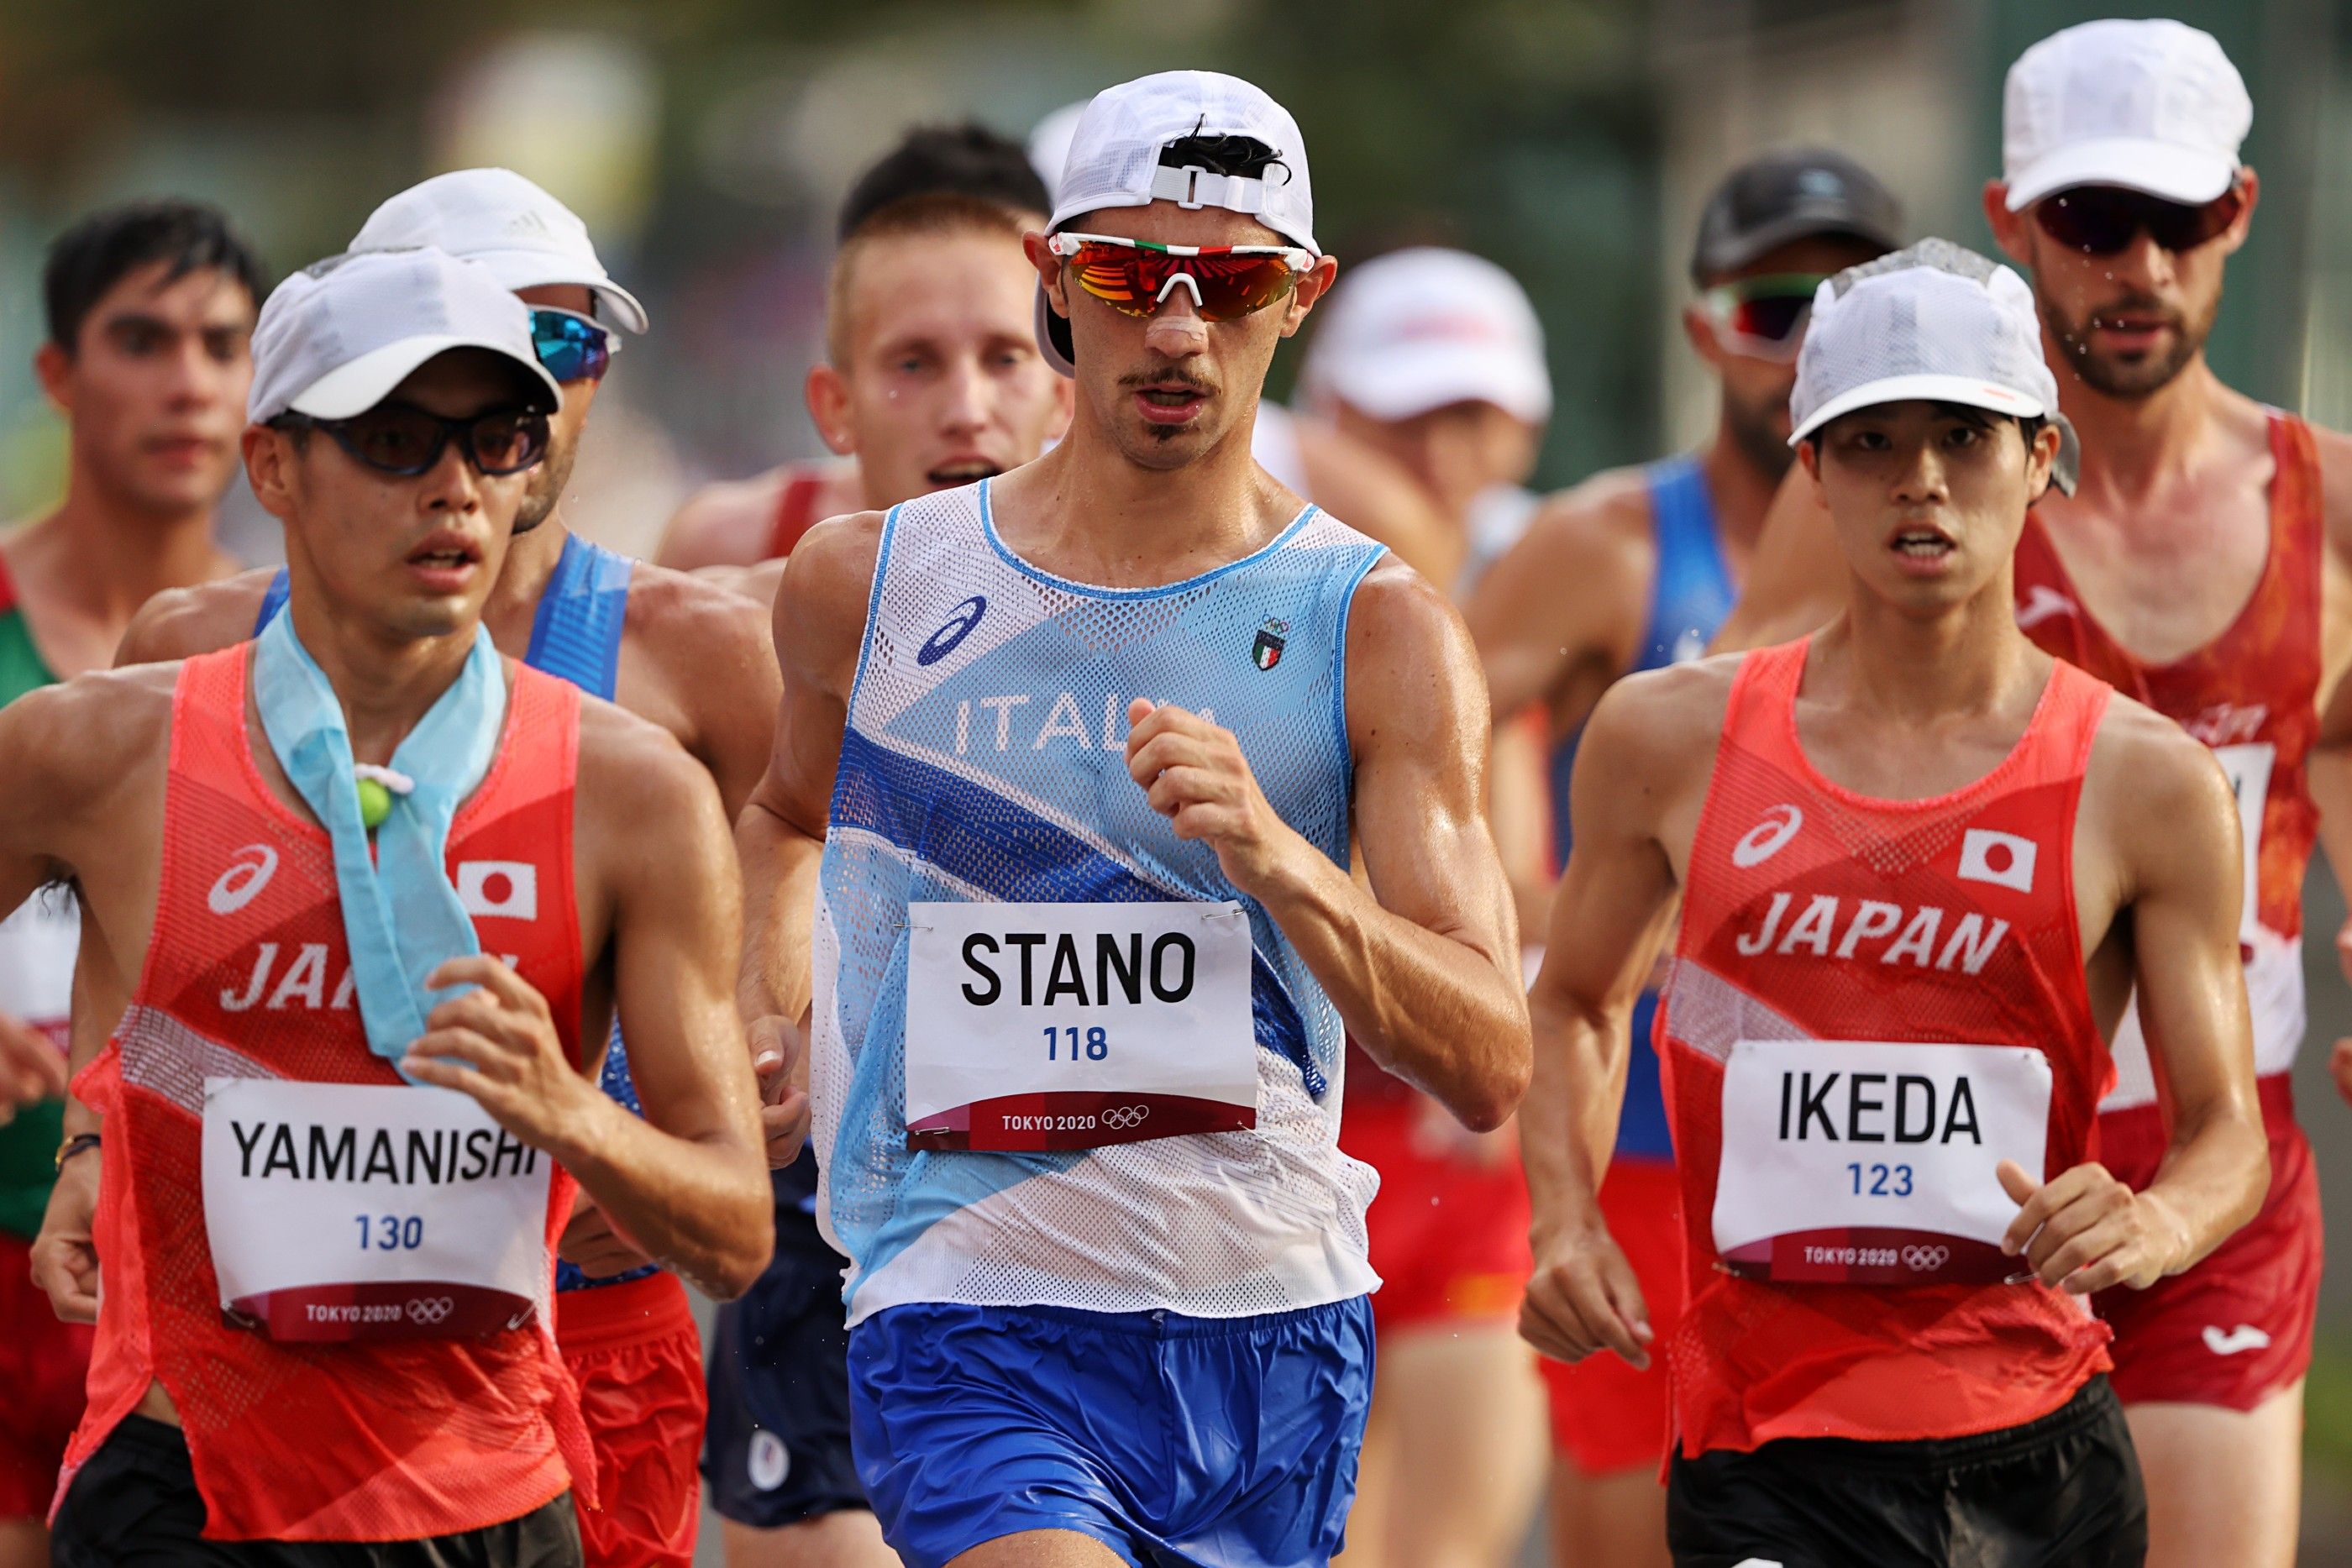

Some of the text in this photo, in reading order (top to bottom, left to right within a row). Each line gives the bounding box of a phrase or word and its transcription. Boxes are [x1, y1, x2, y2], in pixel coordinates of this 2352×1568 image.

[955, 692, 1215, 755] ITAL
[1736, 892, 2009, 975] JAPAN
[961, 931, 1195, 1006] STANO
[1043, 1026, 1108, 1061] 118
[1002, 1115, 1096, 1130] TOKYO 2020
[1779, 1072, 1982, 1145] IKEDA
[1847, 1162, 1914, 1197] 123
[355, 1214, 423, 1251] 130
[1803, 1245, 1898, 1266] TOKYO 2020
[306, 1303, 402, 1323] TOKYO 2020
